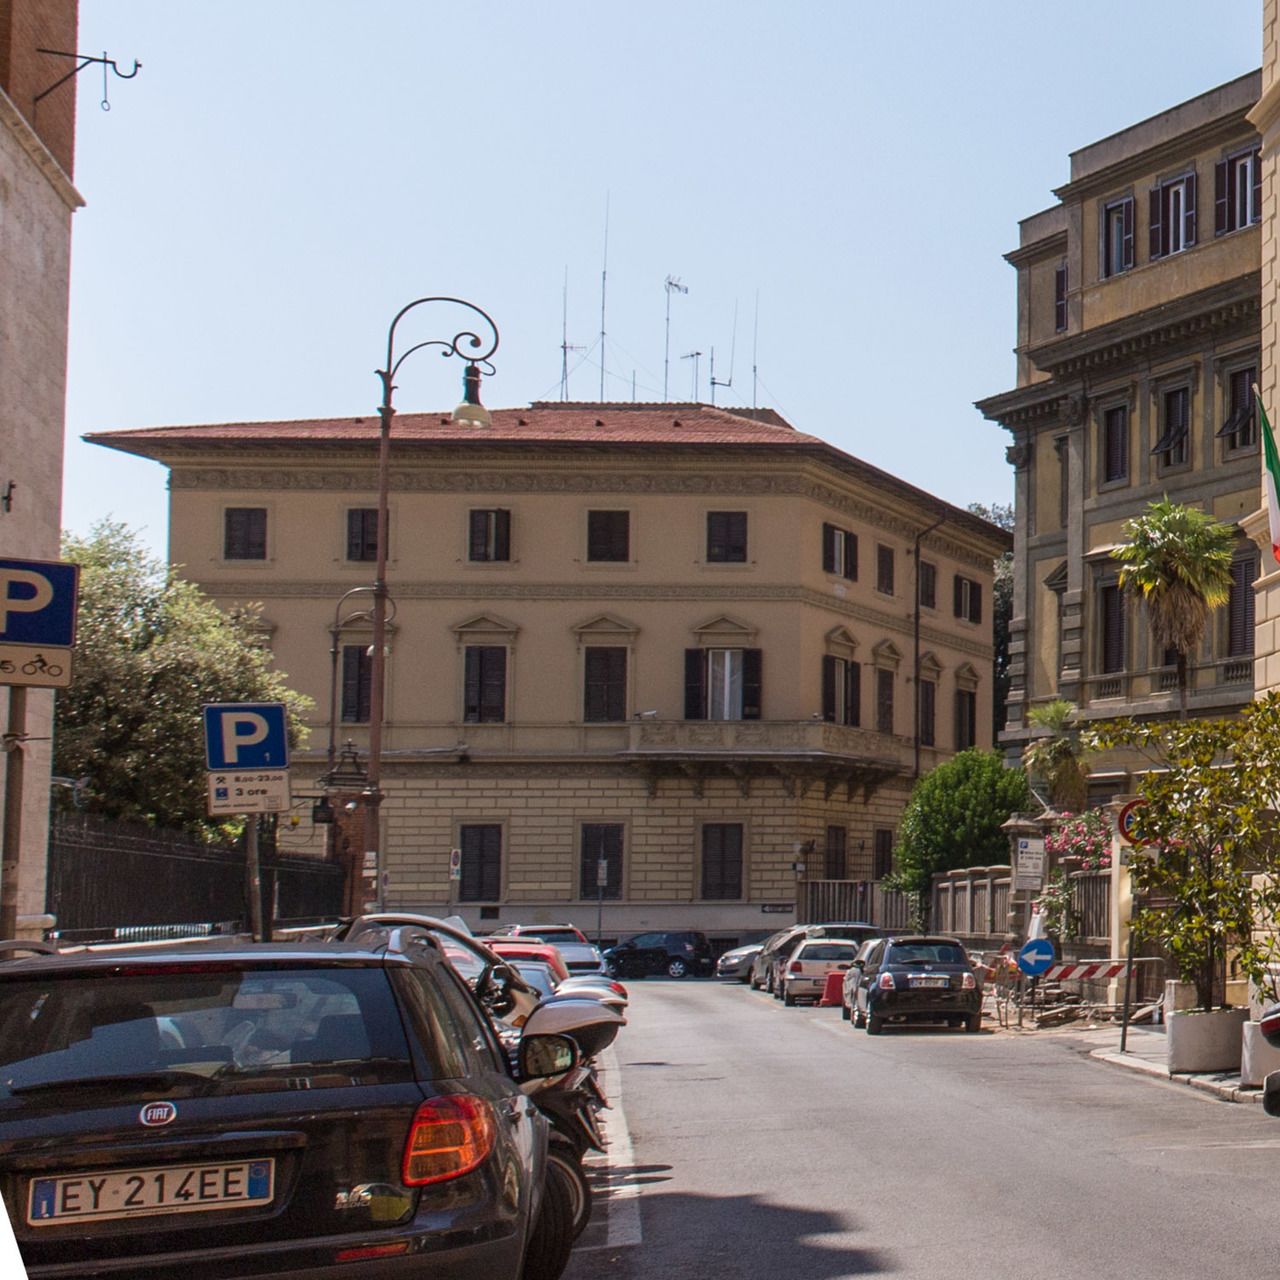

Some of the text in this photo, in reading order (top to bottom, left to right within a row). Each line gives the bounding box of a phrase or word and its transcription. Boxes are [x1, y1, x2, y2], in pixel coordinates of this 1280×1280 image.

[0, 568, 54, 634] P
[221, 712, 270, 764] P
[264, 752, 270, 762] 1
[235, 788, 268, 796] 3 ore
[146, 1107, 169, 1120] FIAT
[60, 1167, 244, 1213] EY 214EE
